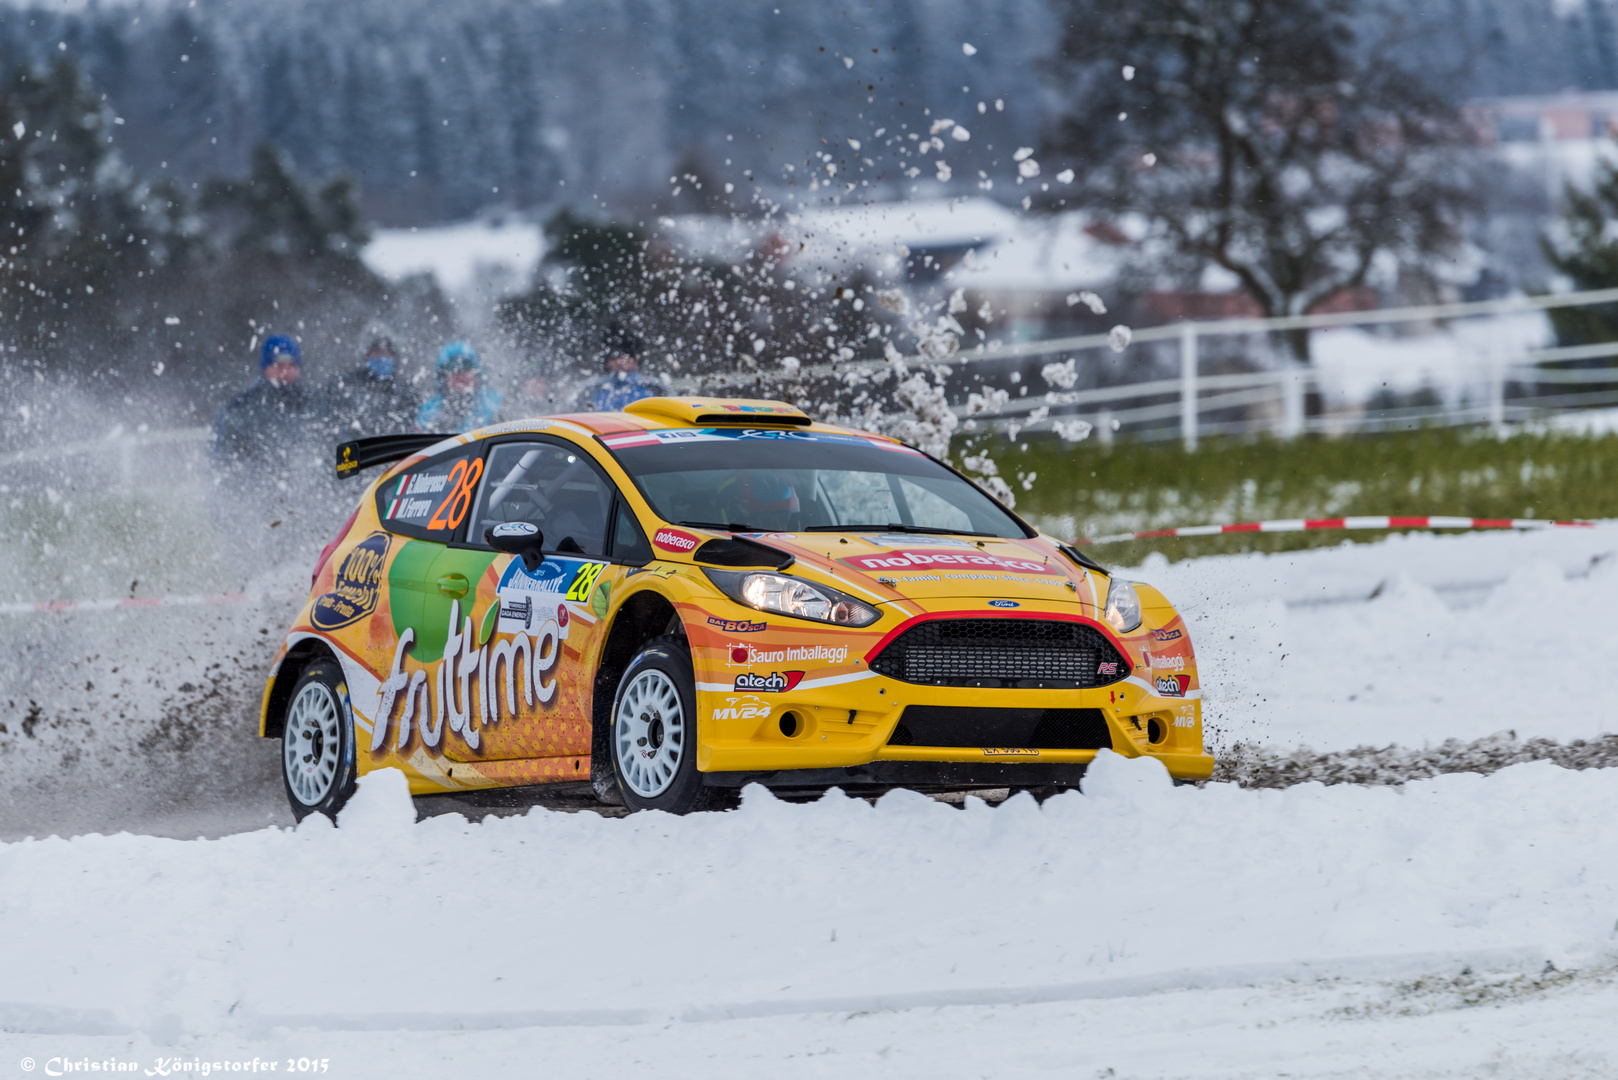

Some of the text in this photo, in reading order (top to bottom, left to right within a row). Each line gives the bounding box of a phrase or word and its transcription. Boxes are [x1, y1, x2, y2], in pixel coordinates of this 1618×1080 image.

[427, 457, 484, 530] 28
[655, 531, 696, 550] noberasco
[343, 547, 381, 585] 100%
[860, 552, 1046, 572] noberasco
[564, 562, 604, 602] 28
[1001, 575, 1032, 583] since
[708, 617, 766, 632] BALBOSCA
[750, 645, 848, 664] Sauro Imballaggi
[371, 599, 559, 752] fruttime
[1096, 662, 1118, 675] RS
[736, 673, 785, 688] atech
[712, 706, 772, 721] MV24
